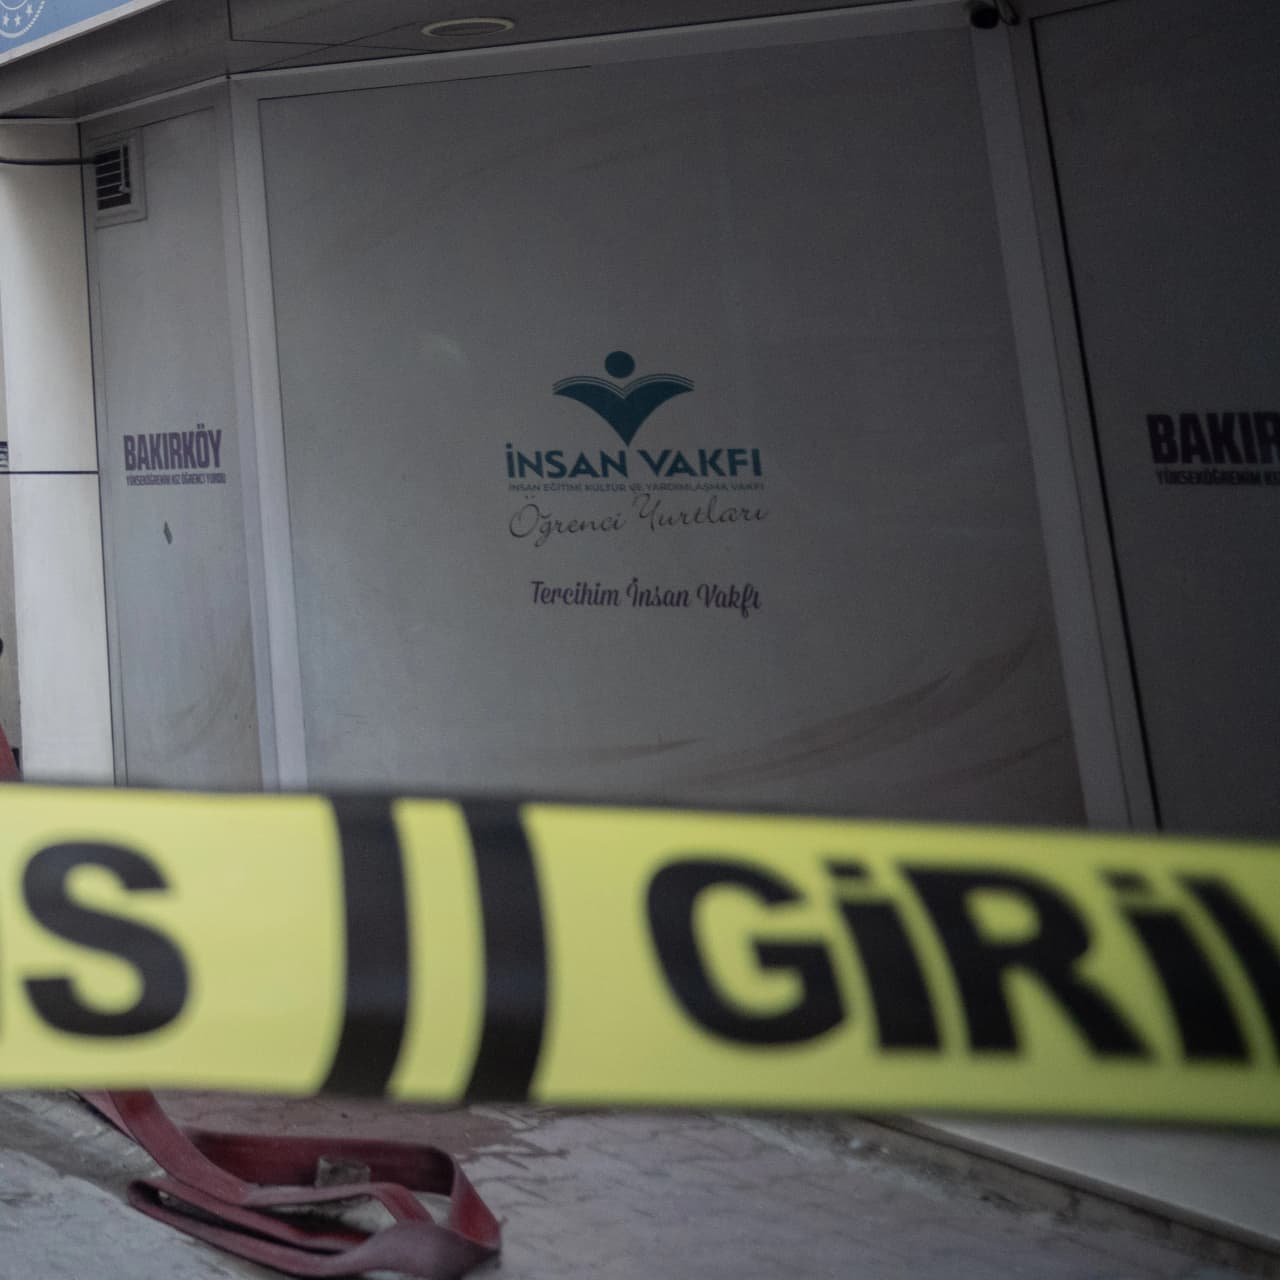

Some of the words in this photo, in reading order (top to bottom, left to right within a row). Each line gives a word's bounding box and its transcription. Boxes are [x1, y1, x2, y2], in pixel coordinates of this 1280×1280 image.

[123, 423, 222, 471] BAKIRKÖY
[505, 443, 628, 478] İNSAN
[637, 448, 763, 477] VAKFI
[509, 495, 627, 547] Öğrenci
[632, 492, 769, 532] Yurtları
[530, 581, 620, 608] Tercihim
[626, 577, 691, 608] İnsan
[697, 583, 763, 619] Vakfı
